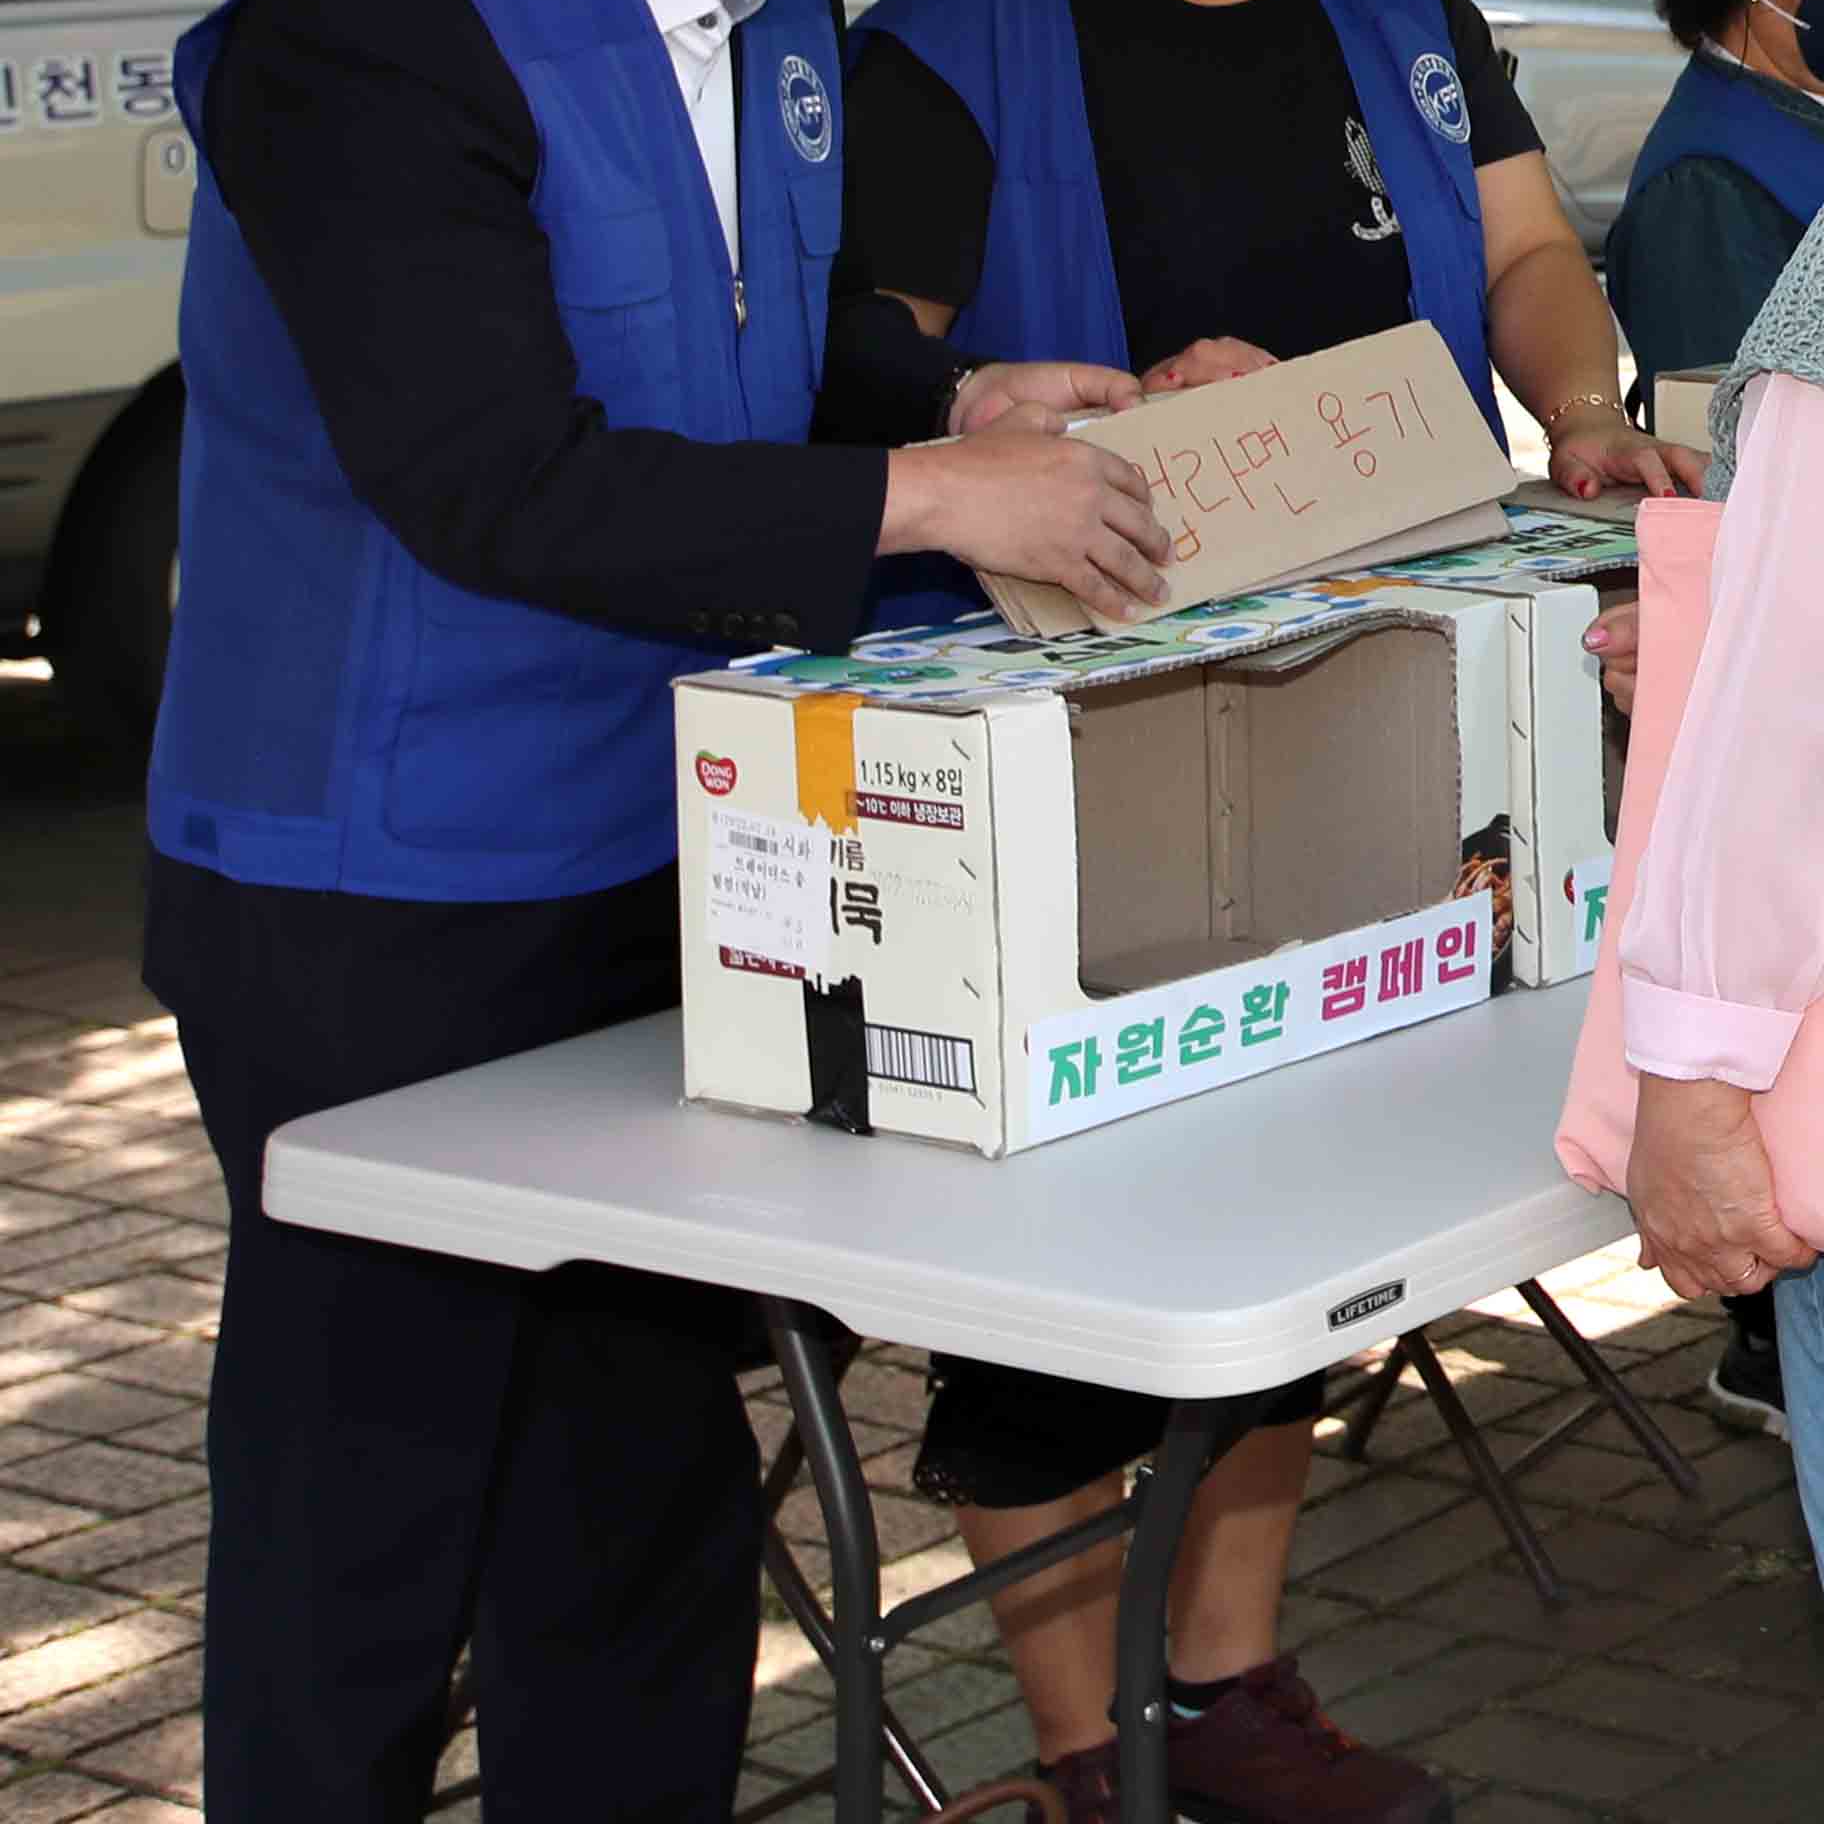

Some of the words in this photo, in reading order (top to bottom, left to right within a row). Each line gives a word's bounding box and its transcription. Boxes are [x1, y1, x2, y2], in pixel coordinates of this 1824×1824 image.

[1318, 375, 1434, 478] 용기
[701, 761, 733, 778] DONG
[704, 776, 731, 791] WON
[861, 759, 894, 786] 1.15
[898, 761, 918, 793] kg
[936, 768, 963, 797] 8입
[889, 800, 912, 820] 이하
[913, 804, 963, 828] 냉장보관
[1048, 980, 1291, 1106] 자원순환
[1321, 921, 1477, 1022] 캠페인
